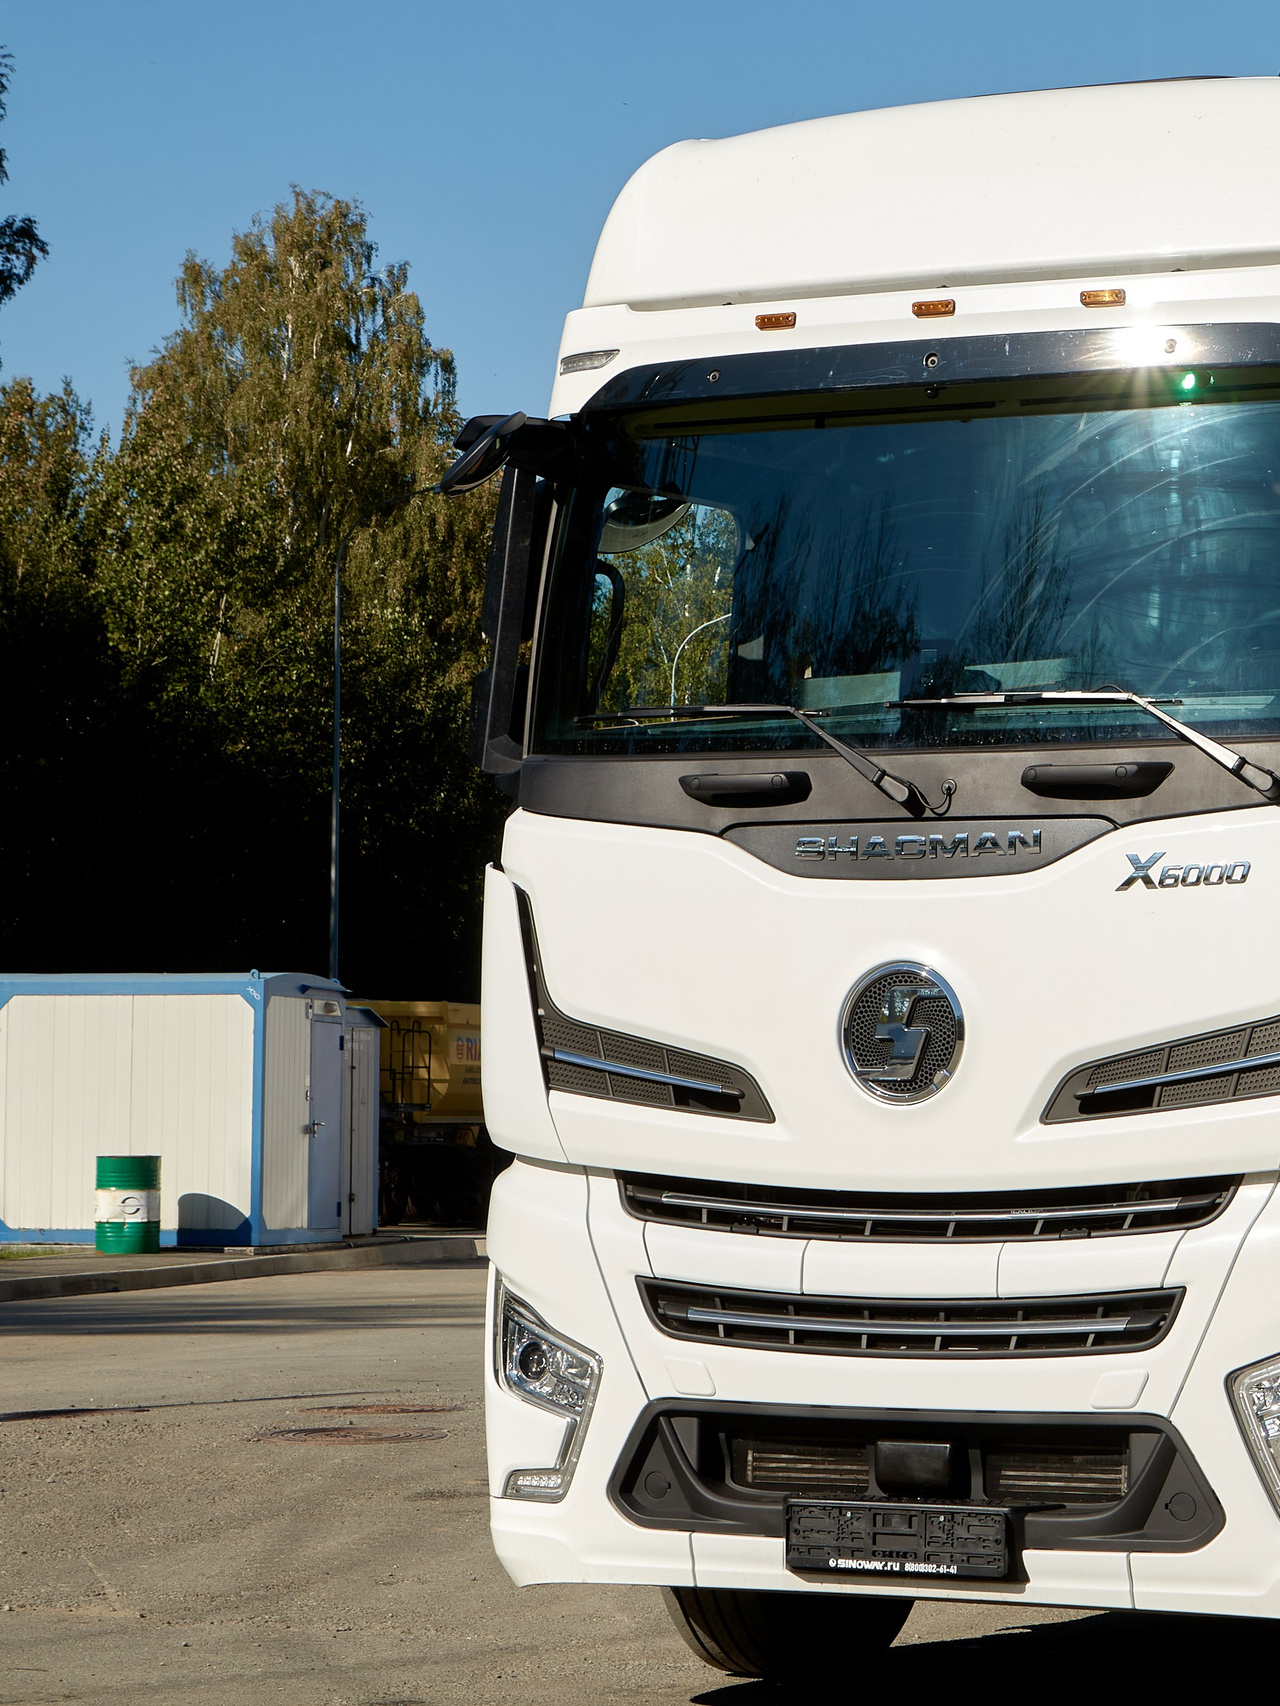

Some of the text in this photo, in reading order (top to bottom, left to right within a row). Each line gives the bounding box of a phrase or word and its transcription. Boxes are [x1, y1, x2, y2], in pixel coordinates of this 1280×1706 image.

[795, 829, 1042, 861] SHACMAN
[1115, 851, 1251, 891] X6000
[837, 1559, 900, 1571] SINOWAY.ru
